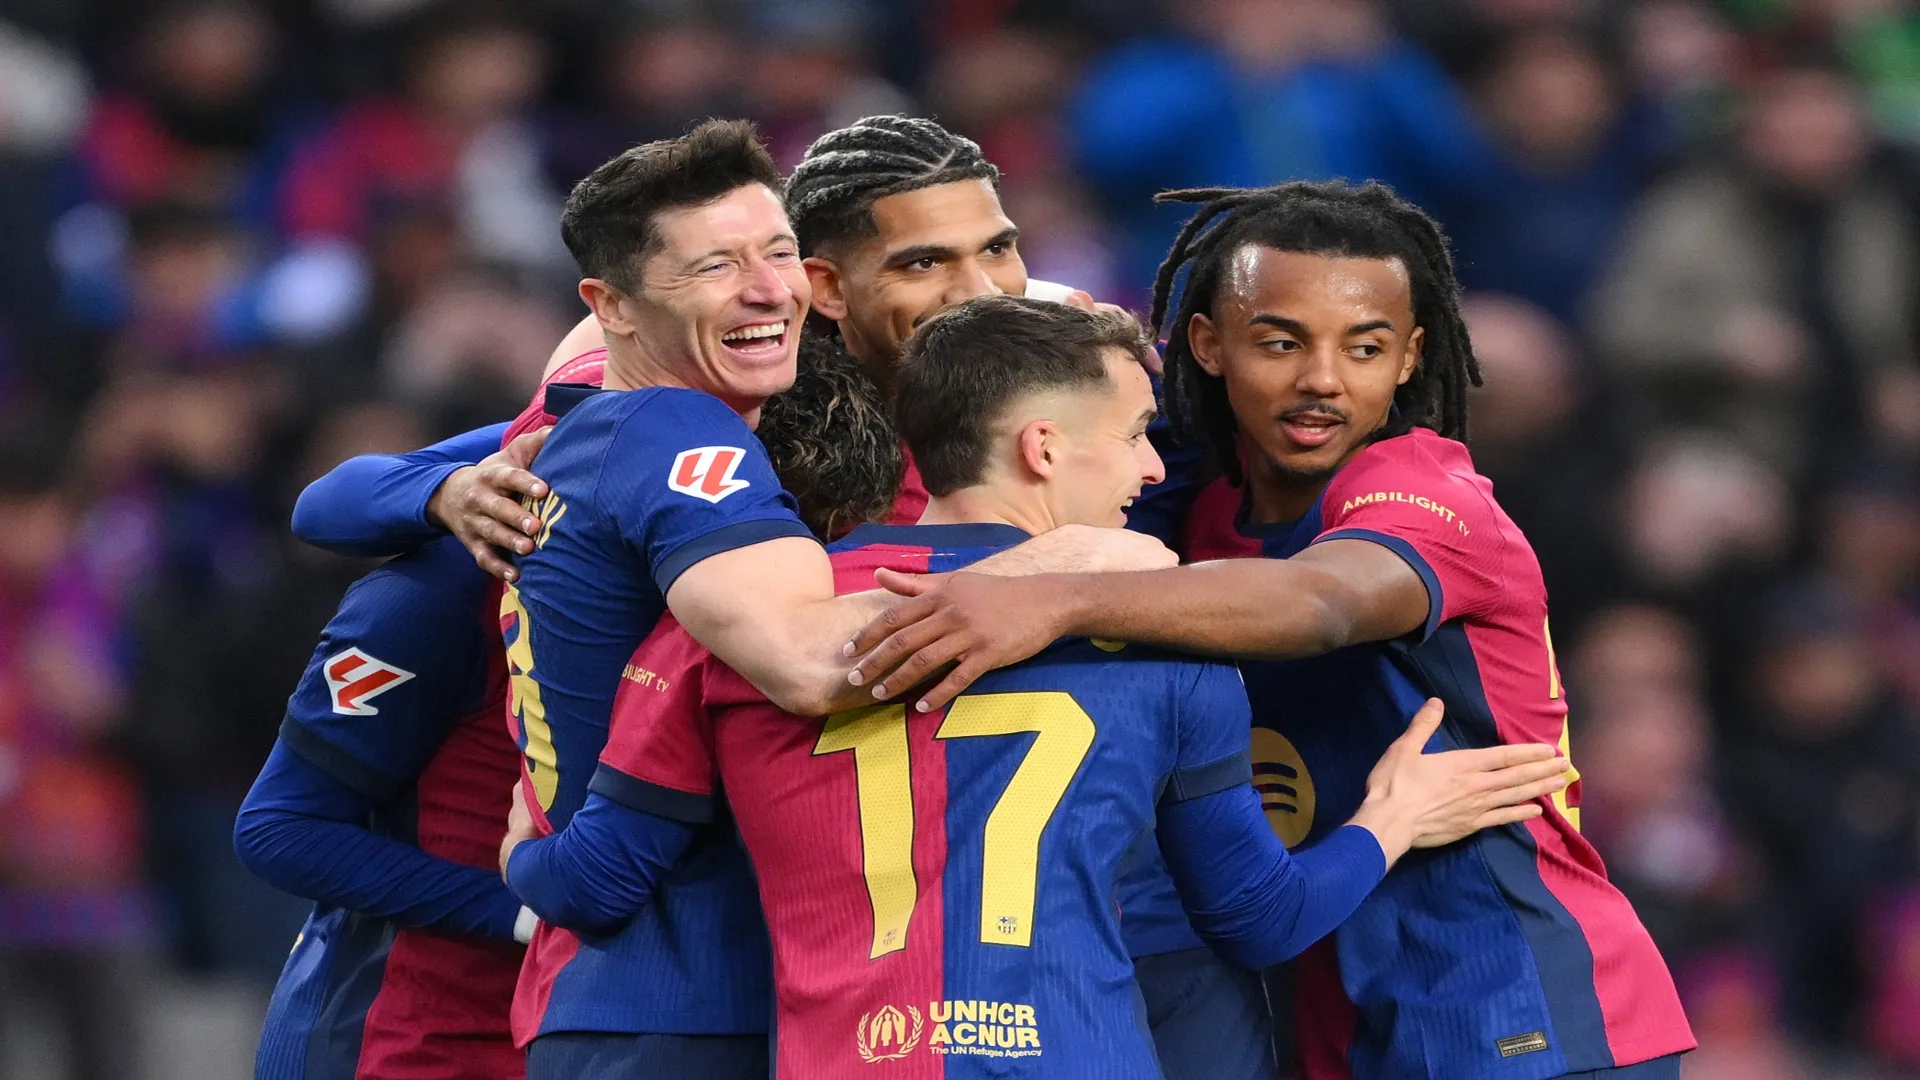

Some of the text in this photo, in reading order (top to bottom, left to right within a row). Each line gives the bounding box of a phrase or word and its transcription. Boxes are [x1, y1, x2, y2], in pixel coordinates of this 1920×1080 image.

[1342, 491, 1471, 537] AMBILIGHT tv
[655, 677, 670, 693] tv
[811, 691, 1096, 960] 17
[929, 1001, 1037, 1026] UNHCR
[928, 1022, 1041, 1048] ACNUR
[929, 1046, 1042, 1059] The UN Refugee Agency
